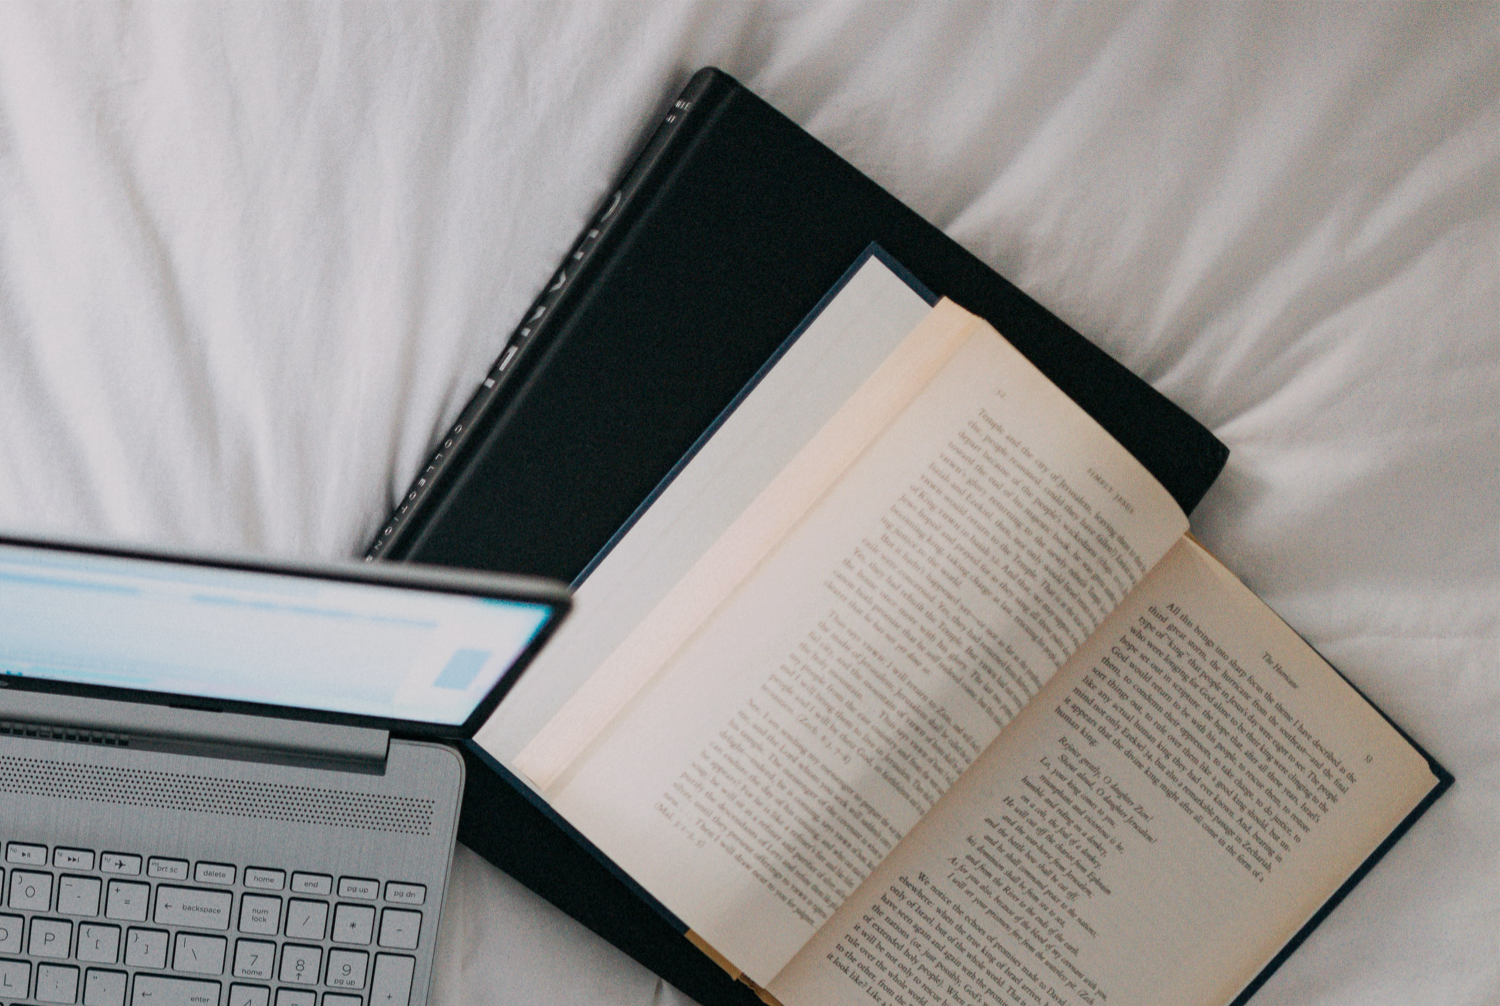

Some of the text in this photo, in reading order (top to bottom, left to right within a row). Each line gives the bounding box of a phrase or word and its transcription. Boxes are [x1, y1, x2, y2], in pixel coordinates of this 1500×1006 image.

[1262, 651, 1299, 690] The Hurricane
[1166, 603, 1181, 616] All
[1179, 614, 1193, 628] this
[1194, 625, 1215, 648] brings
[1215, 646, 1229, 661] into
[1228, 660, 1247, 678] sharp
[1247, 675, 1264, 694] focus
[1264, 692, 1275, 704] the
[1274, 702, 1294, 722] theme
[1297, 724, 1312, 741] have
[1312, 740, 1342, 768] described
[1346, 772, 1357, 784] the
[1364, 754, 1373, 764] 53
[182, 904, 221, 914] backspace
[43, 932, 56, 945] P
[3, 973, 13, 988] L
